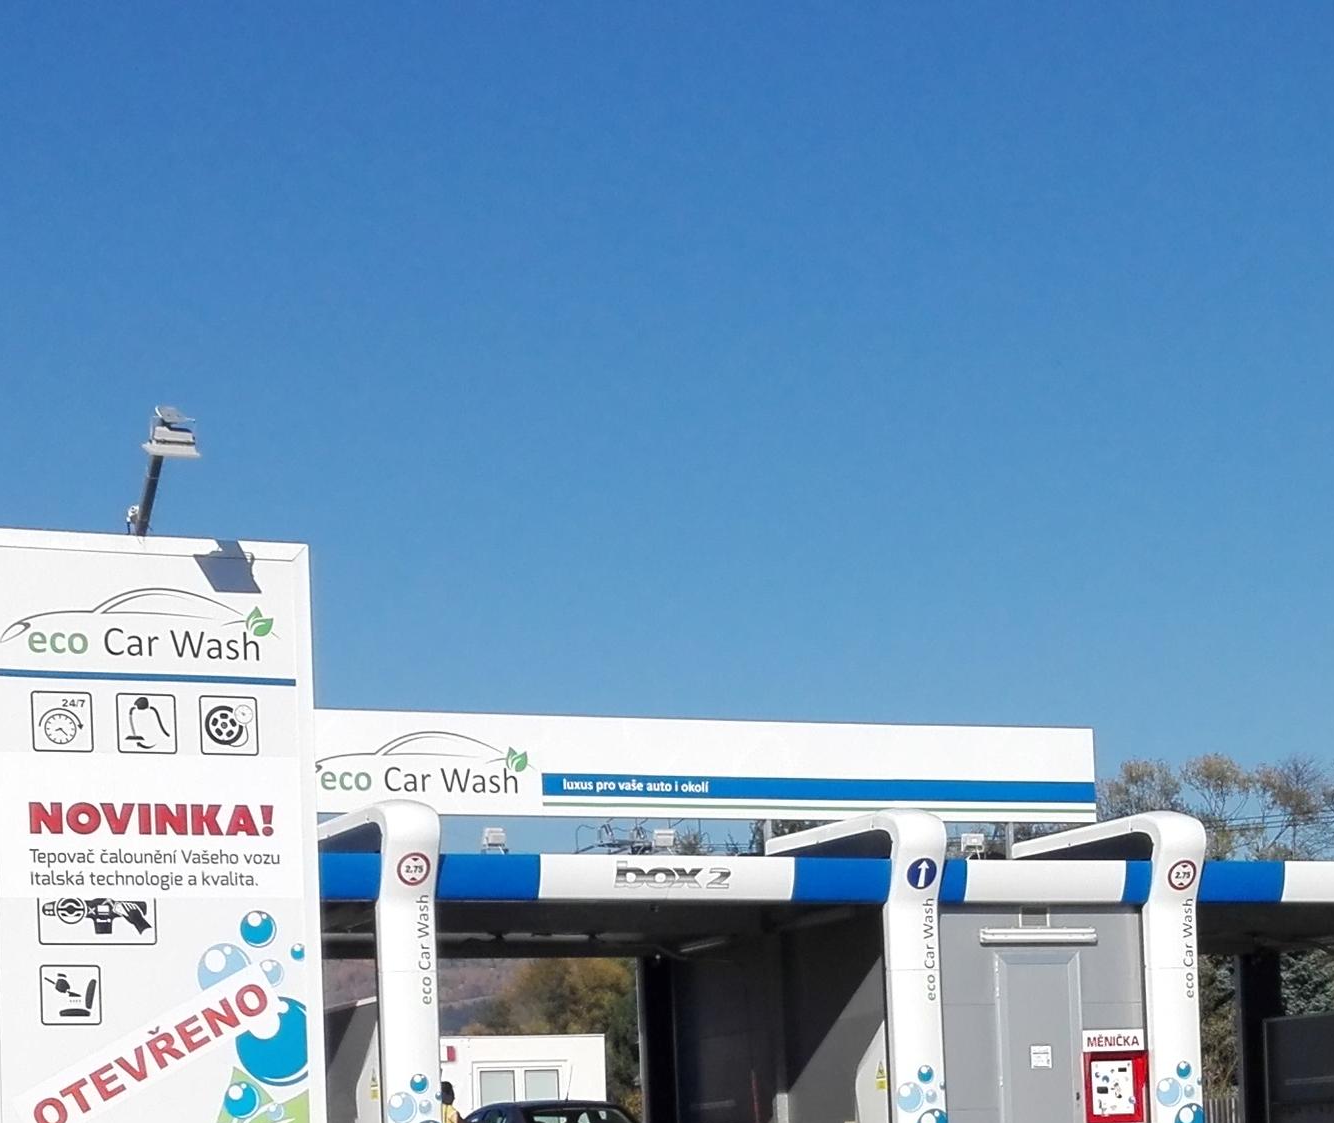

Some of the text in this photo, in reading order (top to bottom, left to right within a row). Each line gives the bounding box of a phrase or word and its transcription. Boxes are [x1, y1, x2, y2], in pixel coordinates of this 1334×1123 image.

[28, 628, 261, 661] eco Car Wash
[62, 699, 85, 708] 24/7
[320, 766, 519, 794] eco Car Wash
[563, 778, 710, 793] luxus pro vaše auto i okolí
[28, 801, 275, 837] NOVINKA!
[29, 848, 281, 868] Tepovač čalounění Vašeho vozu
[405, 865, 423, 874] 2.75
[30, 870, 259, 890] Italská technologie a kvalita.
[614, 861, 731, 889] box 2
[416, 894, 432, 1005] eco Car Wash
[923, 898, 936, 1001] eco Car Wash
[1182, 898, 1194, 998] eco Car Wash
[1086, 1034, 1140, 1047] MĚNIČKA
